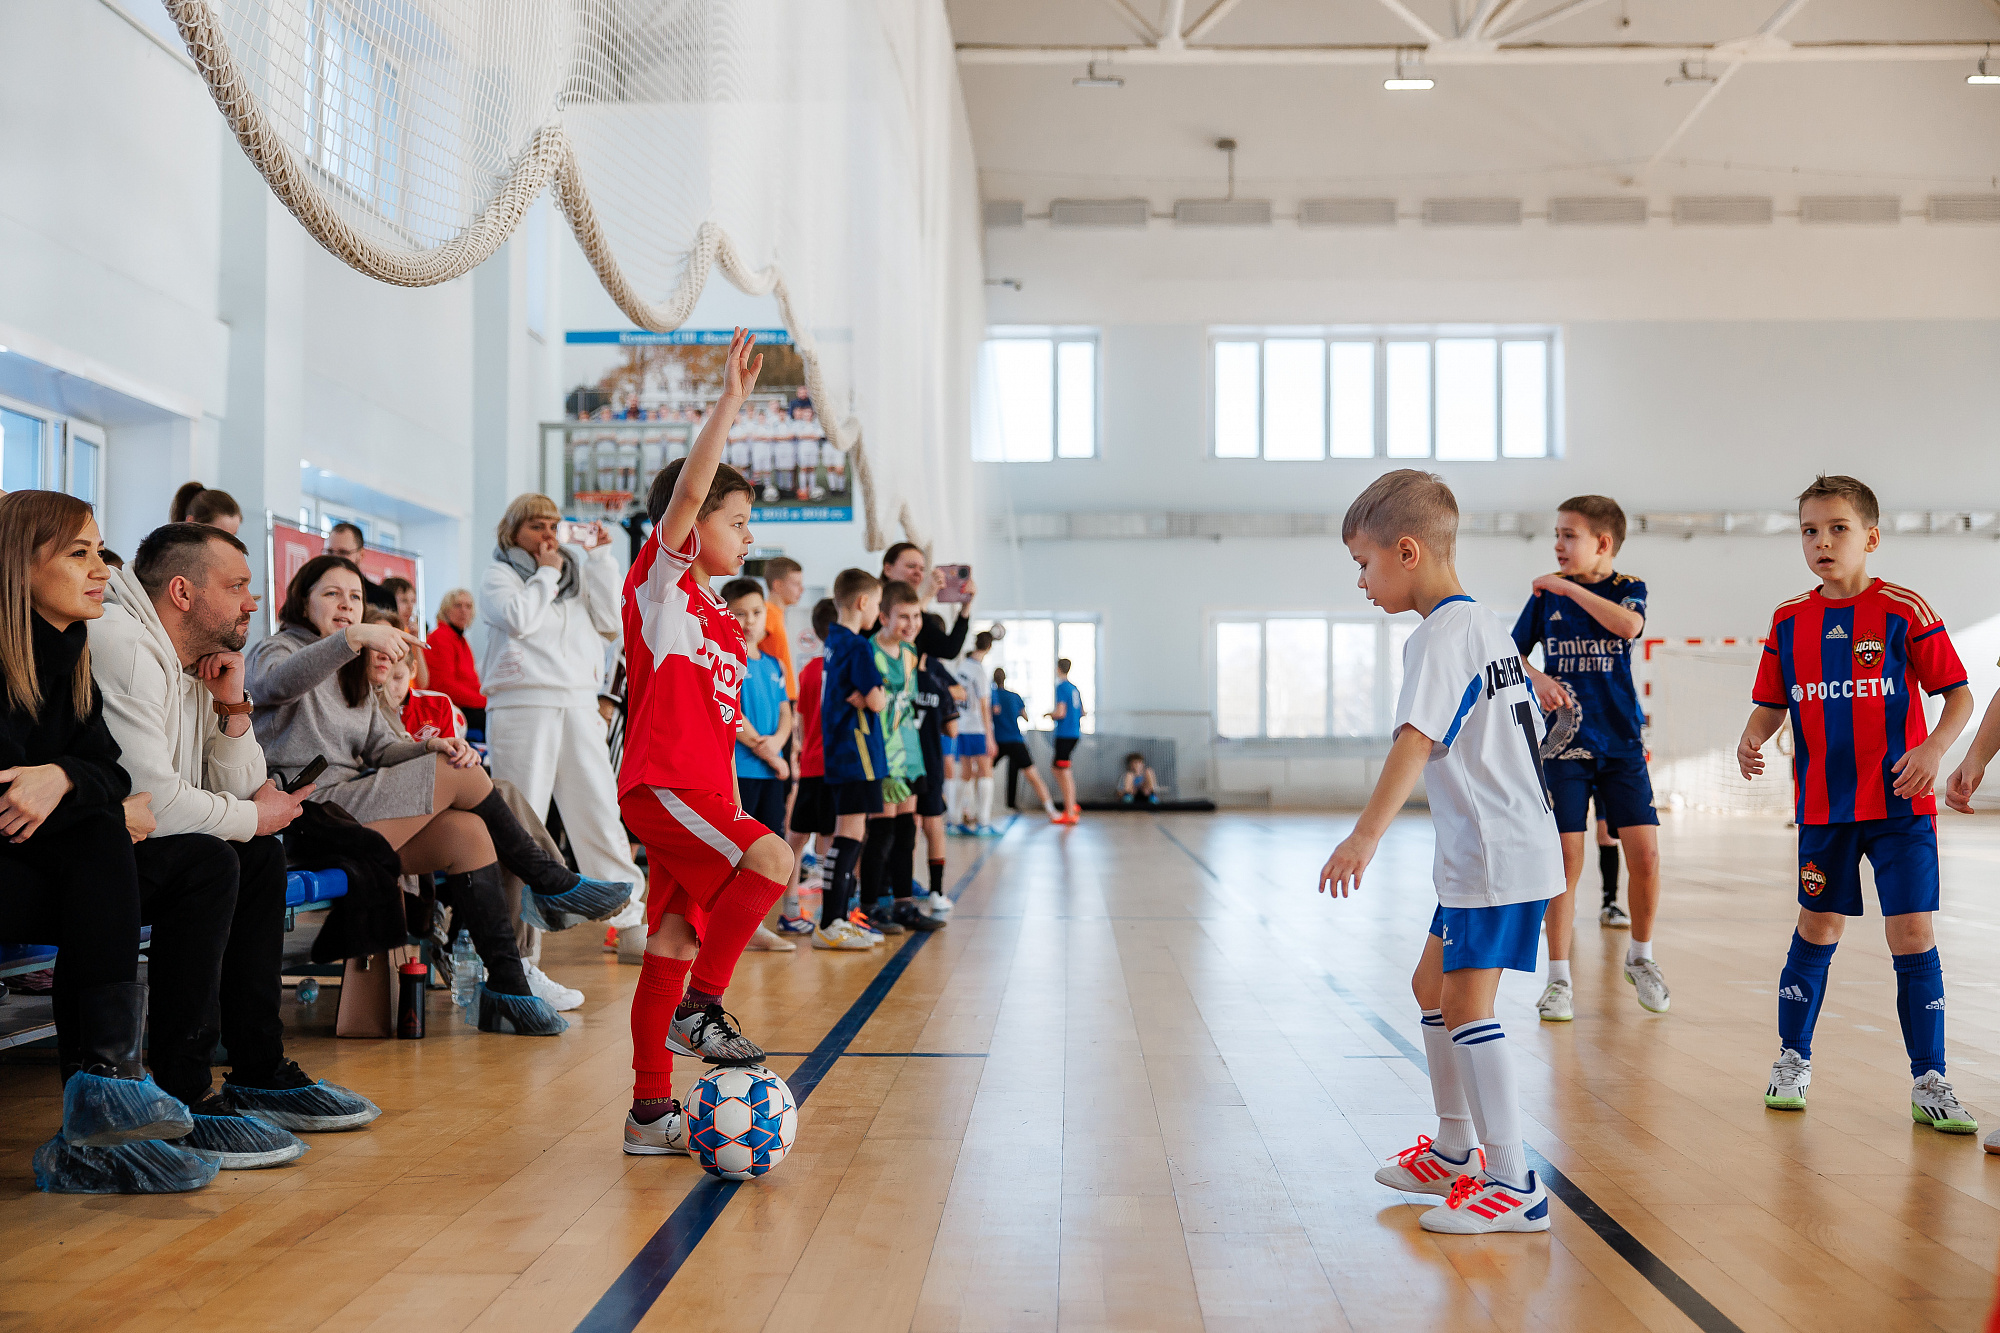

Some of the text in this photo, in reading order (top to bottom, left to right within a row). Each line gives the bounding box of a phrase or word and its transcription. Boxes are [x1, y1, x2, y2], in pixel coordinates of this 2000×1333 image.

[1546, 636, 1624, 656] Emirates
[1855, 640, 1882, 652] ЦСКА
[1558, 656, 1614, 673] FLY BETTER
[1806, 677, 1896, 701] РОССЕТИ
[1801, 870, 1825, 884] ЦСКА
